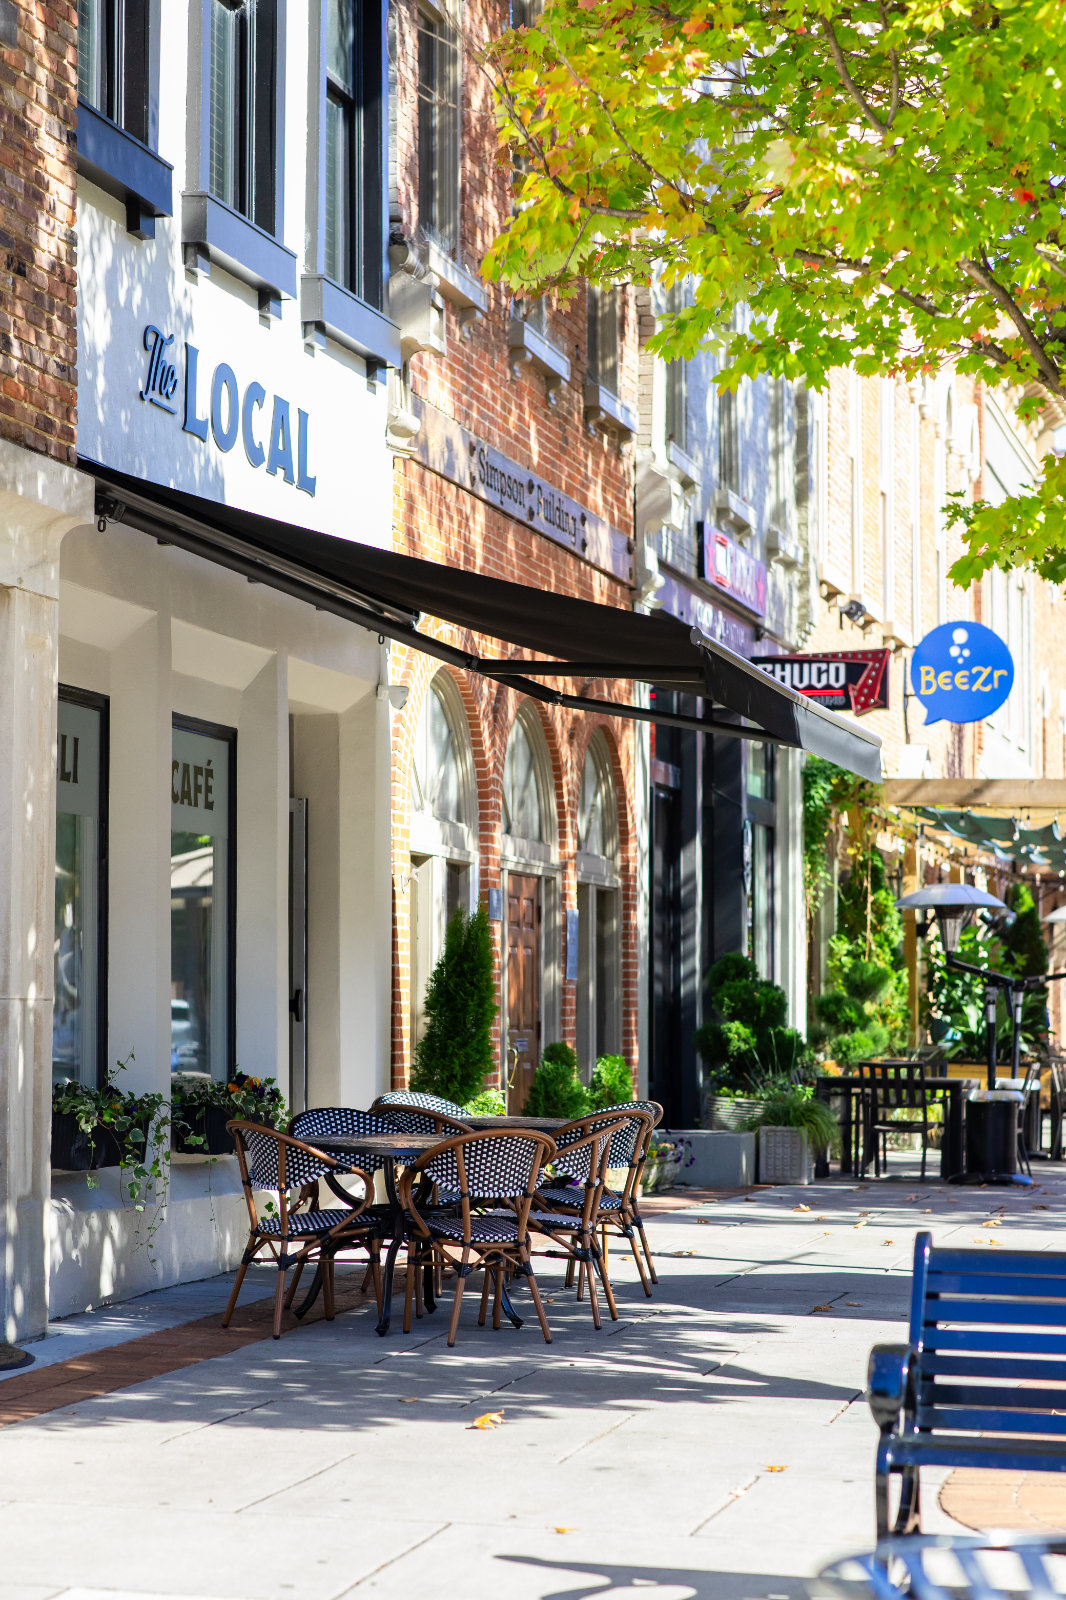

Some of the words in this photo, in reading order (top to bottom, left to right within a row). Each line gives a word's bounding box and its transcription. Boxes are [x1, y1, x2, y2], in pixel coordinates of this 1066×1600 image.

[139, 324, 178, 400] The
[182, 341, 317, 498] LOCAL
[478, 447, 526, 508] Simpson
[536, 484, 577, 546] Building
[56, 733, 80, 784] LI
[172, 759, 215, 811] CAFÉ
